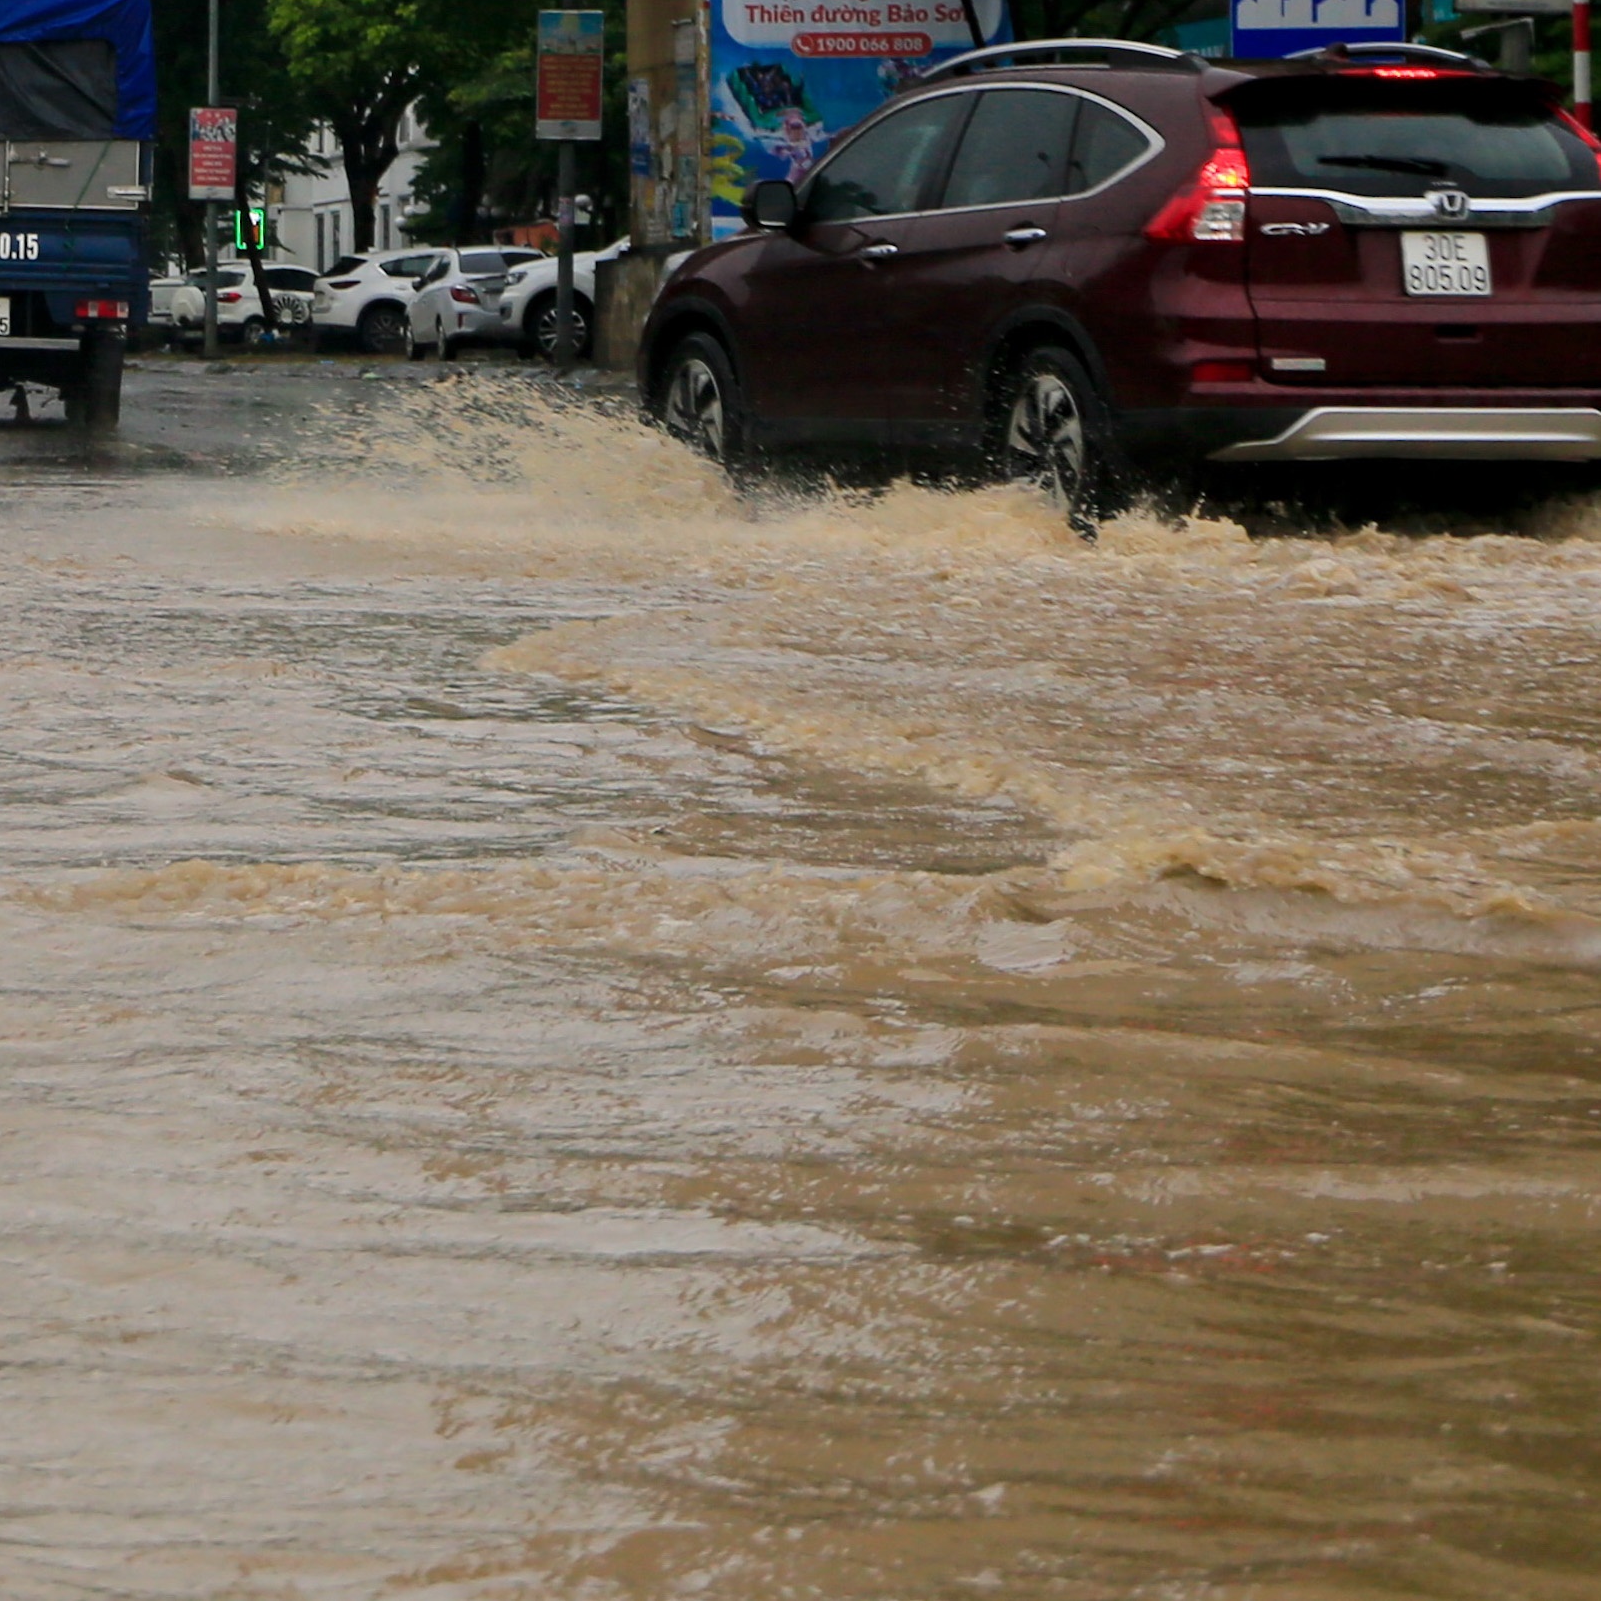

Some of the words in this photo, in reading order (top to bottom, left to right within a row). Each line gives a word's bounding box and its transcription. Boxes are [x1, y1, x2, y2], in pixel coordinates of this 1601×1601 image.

[745, 3, 804, 23] Thiên
[811, 4, 882, 26] đường
[888, 3, 928, 23] Bảo
[816, 38, 856, 52] 1900
[859, 38, 889, 52] 066
[893, 37, 923, 52] 808
[1423, 234, 1467, 262] 30E
[1409, 265, 1487, 292] 805.09
